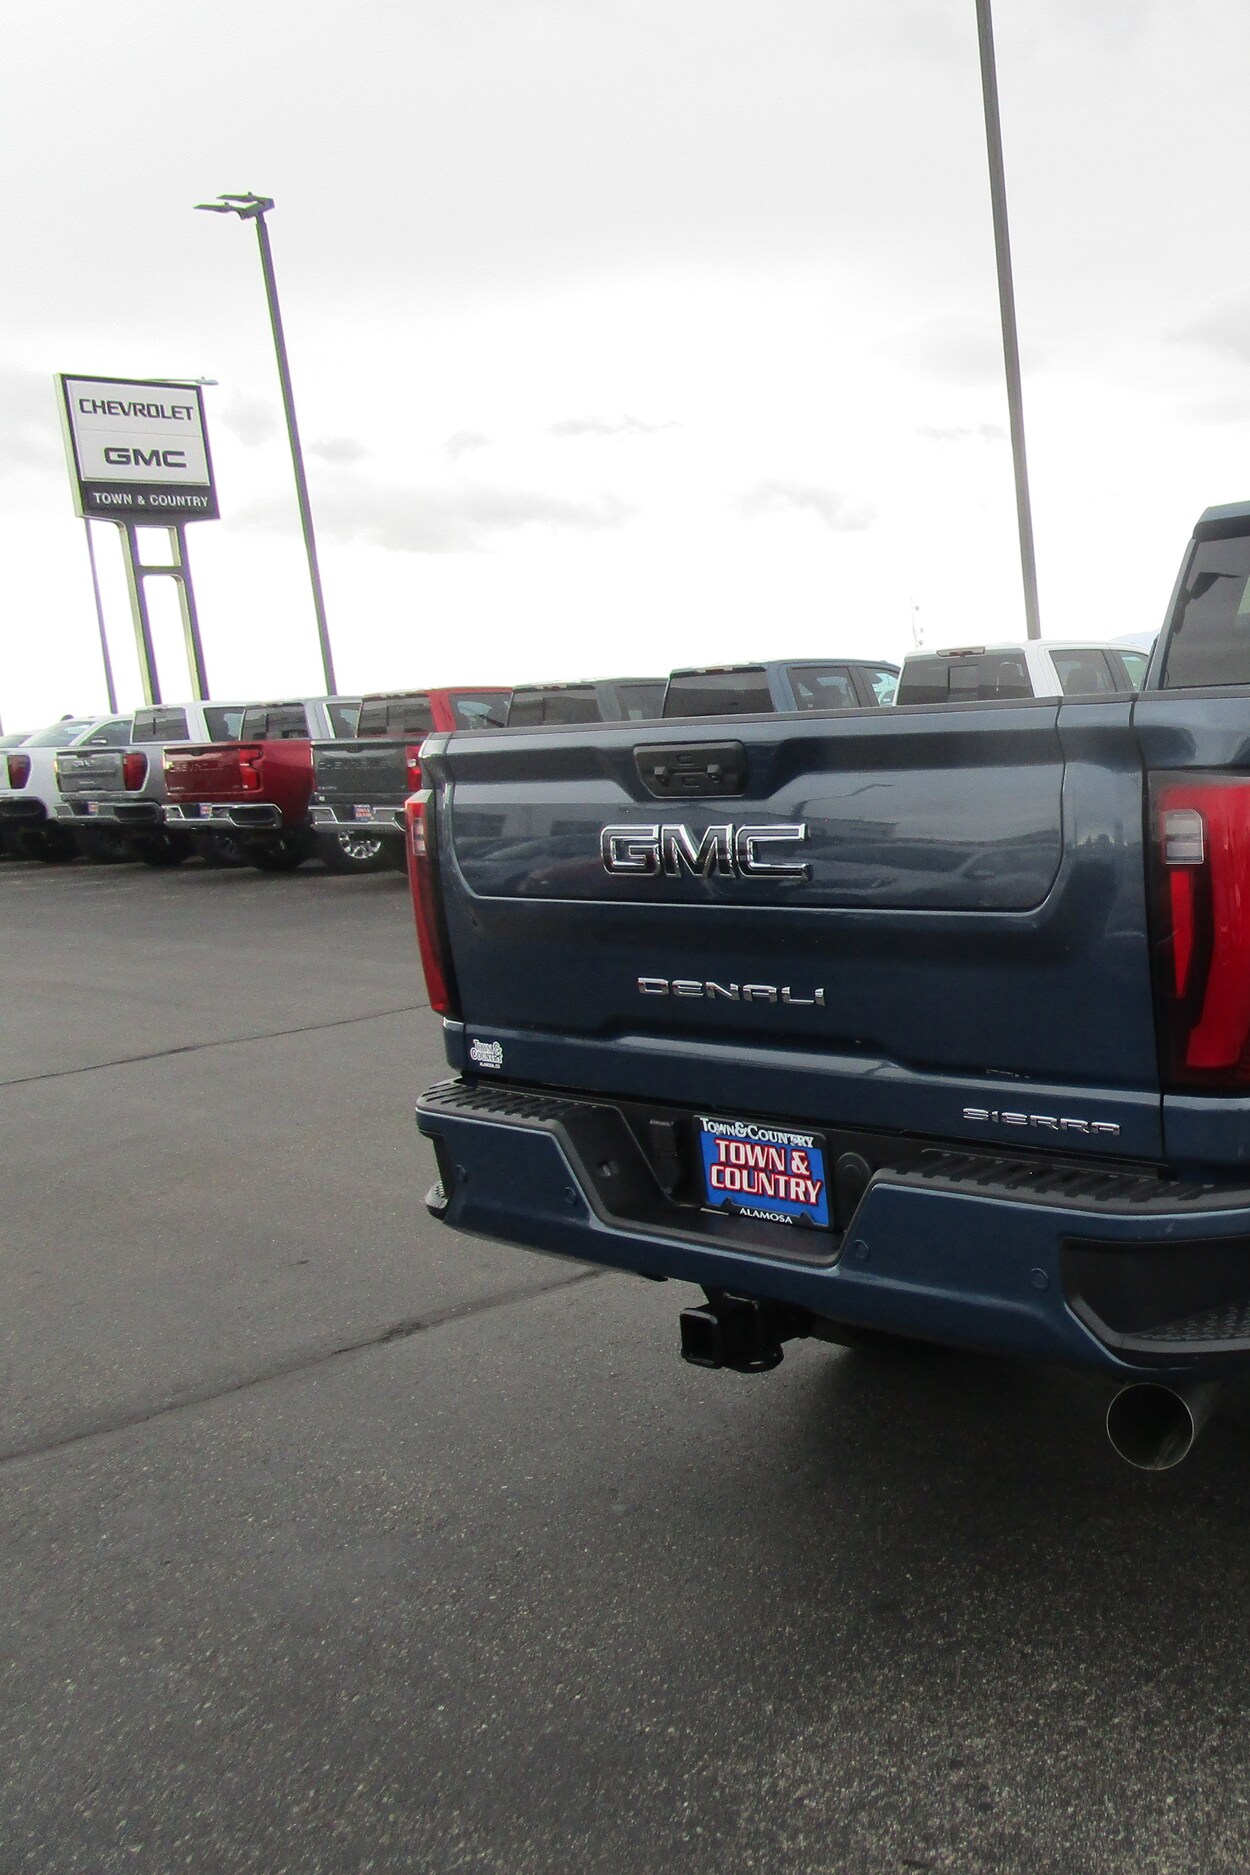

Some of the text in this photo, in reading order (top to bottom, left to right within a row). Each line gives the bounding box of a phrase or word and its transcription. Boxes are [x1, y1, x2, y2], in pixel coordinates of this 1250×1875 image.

[78, 398, 194, 421] CHEVROLET
[104, 447, 187, 468] GMC
[93, 492, 208, 507] TOWN & COUNTRY
[600, 823, 813, 881] GMC
[637, 976, 826, 1006] DENALI
[962, 1107, 1121, 1136] SIERRA
[715, 1139, 810, 1175] TOWN &
[711, 1165, 821, 1204] COUNTRY
[740, 1207, 793, 1224] ALAMOSA
